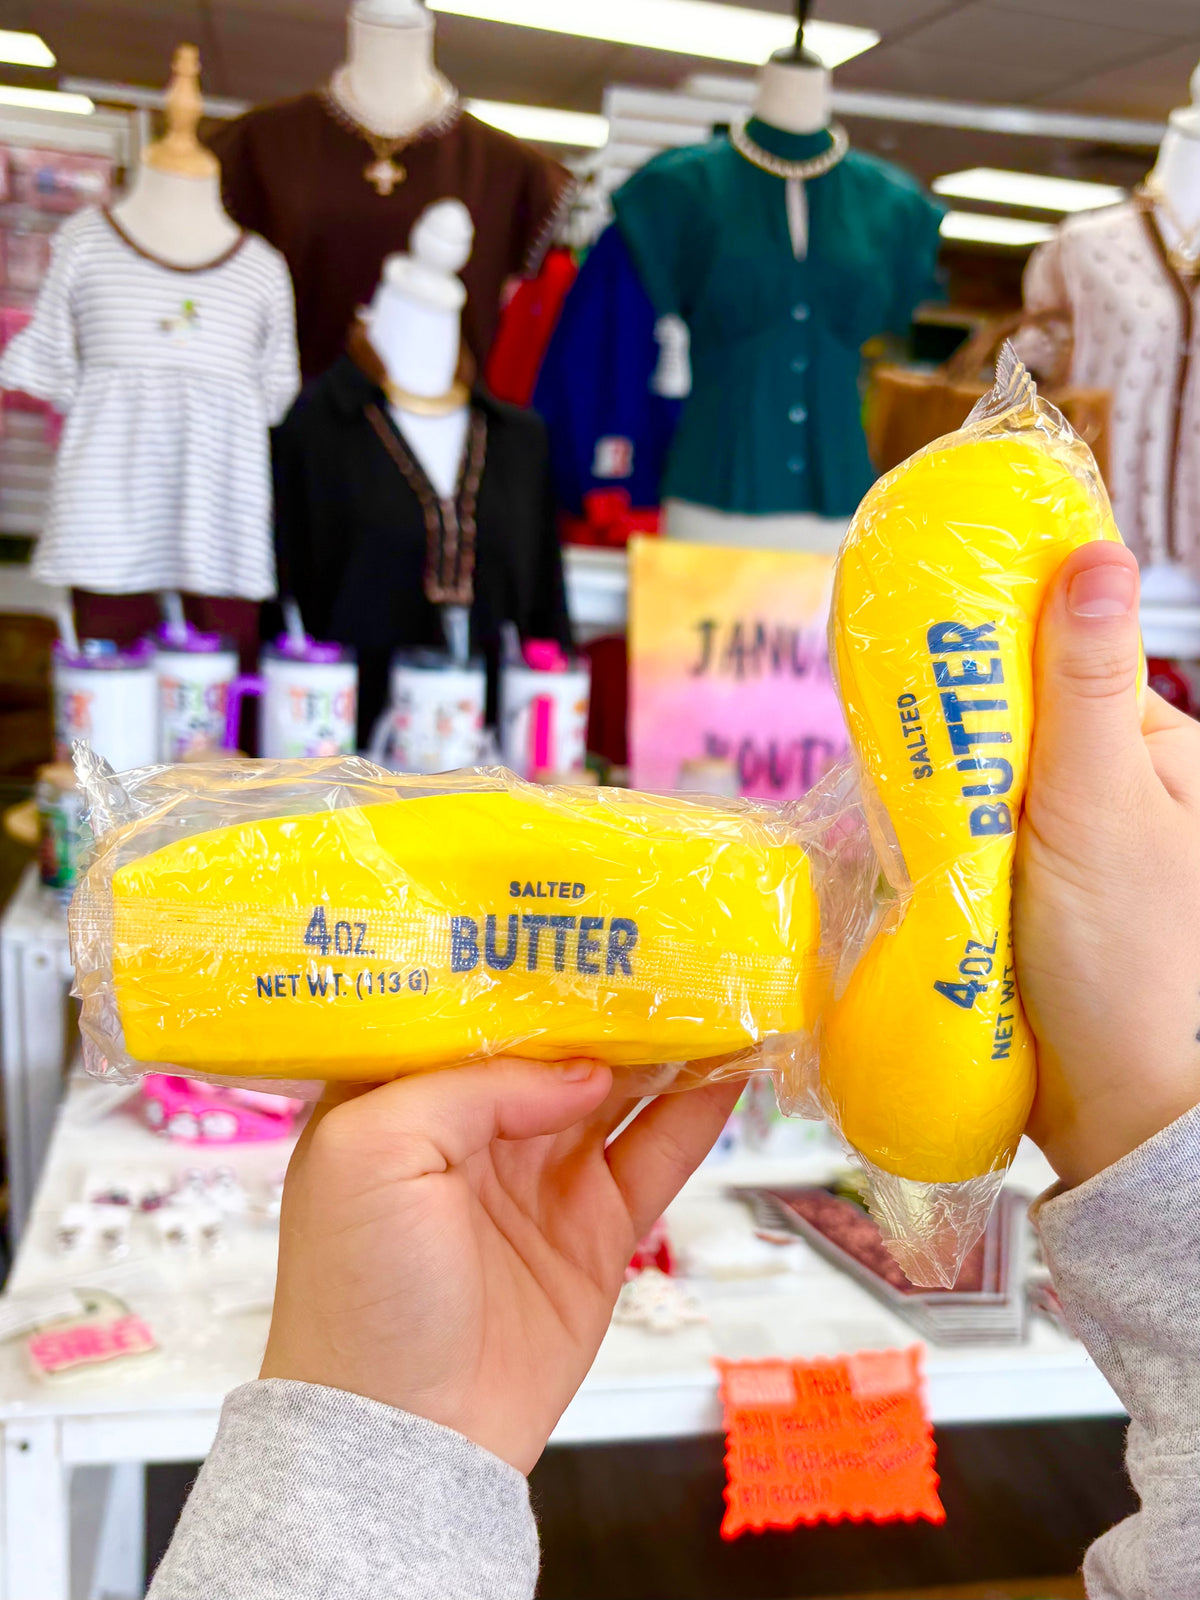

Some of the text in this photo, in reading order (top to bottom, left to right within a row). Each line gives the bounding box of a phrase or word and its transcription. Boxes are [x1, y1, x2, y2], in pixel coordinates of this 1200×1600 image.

[686, 616, 830, 684] JANU
[896, 692, 934, 780] SALTED
[926, 619, 1014, 837] BUTTER
[509, 880, 586, 899] SALTED
[451, 913, 639, 977] BUTTER
[256, 968, 430, 1000] NET WT. (113 G)
[990, 1012, 1015, 1060] NET
